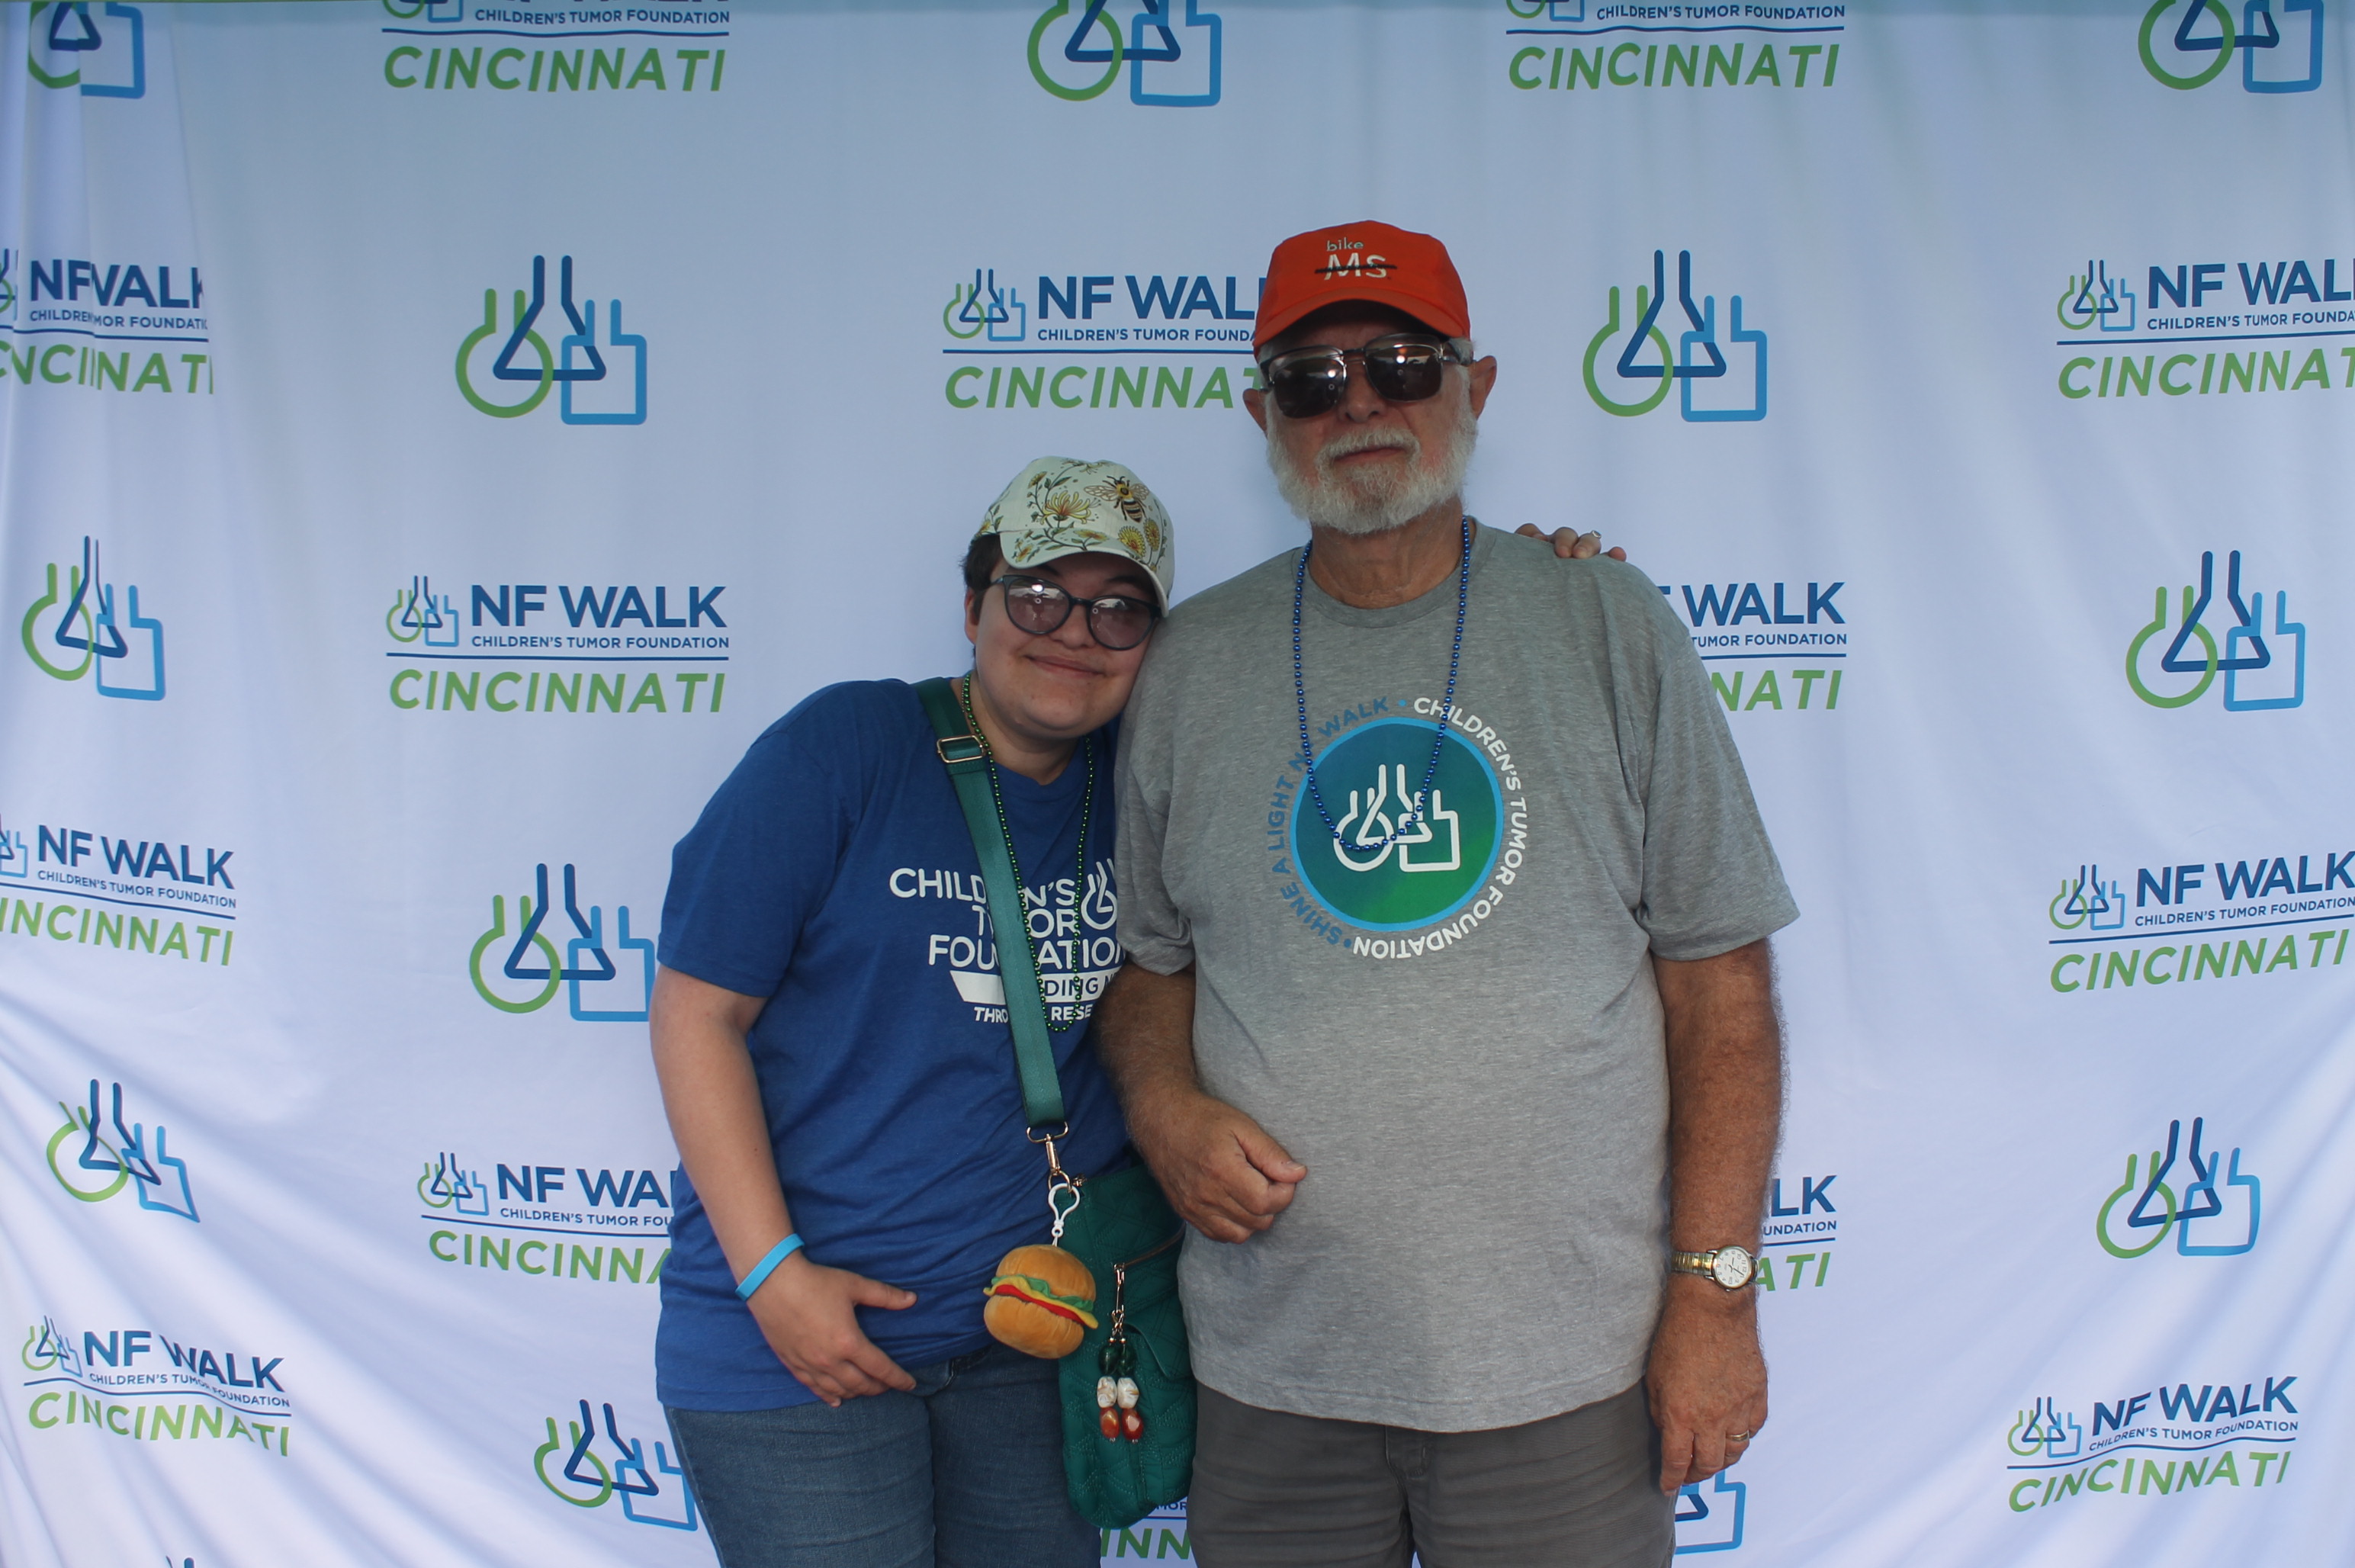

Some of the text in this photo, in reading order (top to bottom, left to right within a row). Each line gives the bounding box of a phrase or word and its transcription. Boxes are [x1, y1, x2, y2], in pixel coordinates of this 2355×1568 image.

[475, 9, 730, 24] CHILDREN'S TUMOR FOUNDATION
[1597, 5, 1845, 21] CHILDREN'S TUMOR FOUNDATION
[384, 46, 725, 92] CINCINNATI
[1508, 42, 1840, 90] CINCINNATI
[1326, 236, 1364, 252] bike
[31, 259, 91, 302] NF
[1324, 252, 1387, 281] MS
[2148, 258, 2355, 309] NF WAL
[1038, 275, 1267, 320] NF WAL
[1037, 328, 1128, 341] CHILDREN'S
[1133, 329, 1190, 341] TUMOR
[2147, 310, 2355, 330] CHILDREN'S TUMOR FOUNDA
[471, 584, 728, 628] NF WALK
[1681, 582, 1846, 627] WALK
[471, 635, 729, 648] CHILDREN'S TUMOR FOUNDATION
[1745, 634, 1847, 646] FOUNDATION
[390, 669, 725, 713] CINCINNATI
[1267, 696, 1390, 945] SHINE A LIGHT N WALK
[1352, 697, 1528, 959] CHILDREN'S TUMOR FOUNDATION
[38, 824, 235, 889] NF WALK
[38, 870, 236, 908] CHILDREN'S TUMOR FOUNDATION
[2136, 850, 2355, 908] NF WALK
[2135, 897, 2355, 927] CHILDREN'S TUMOR FOUNDATION
[2050, 928, 2350, 993] CINCINNATI
[496, 1163, 565, 1203] NF
[500, 1207, 583, 1223] CHILDREN'S
[586, 1214, 638, 1226] TUMOR
[84, 1330, 284, 1393] NF WALK
[89, 1373, 290, 1408] CHILDREN'S TUMOR FOUNDATION
[2092, 1376, 2298, 1436] NF WALK
[29, 1390, 289, 1457] CINCINNATI
[2089, 1419, 2299, 1451] CHILDREN'S TUMOR FOUNDATION
[2008, 1450, 2291, 1512] CINCINNATI
